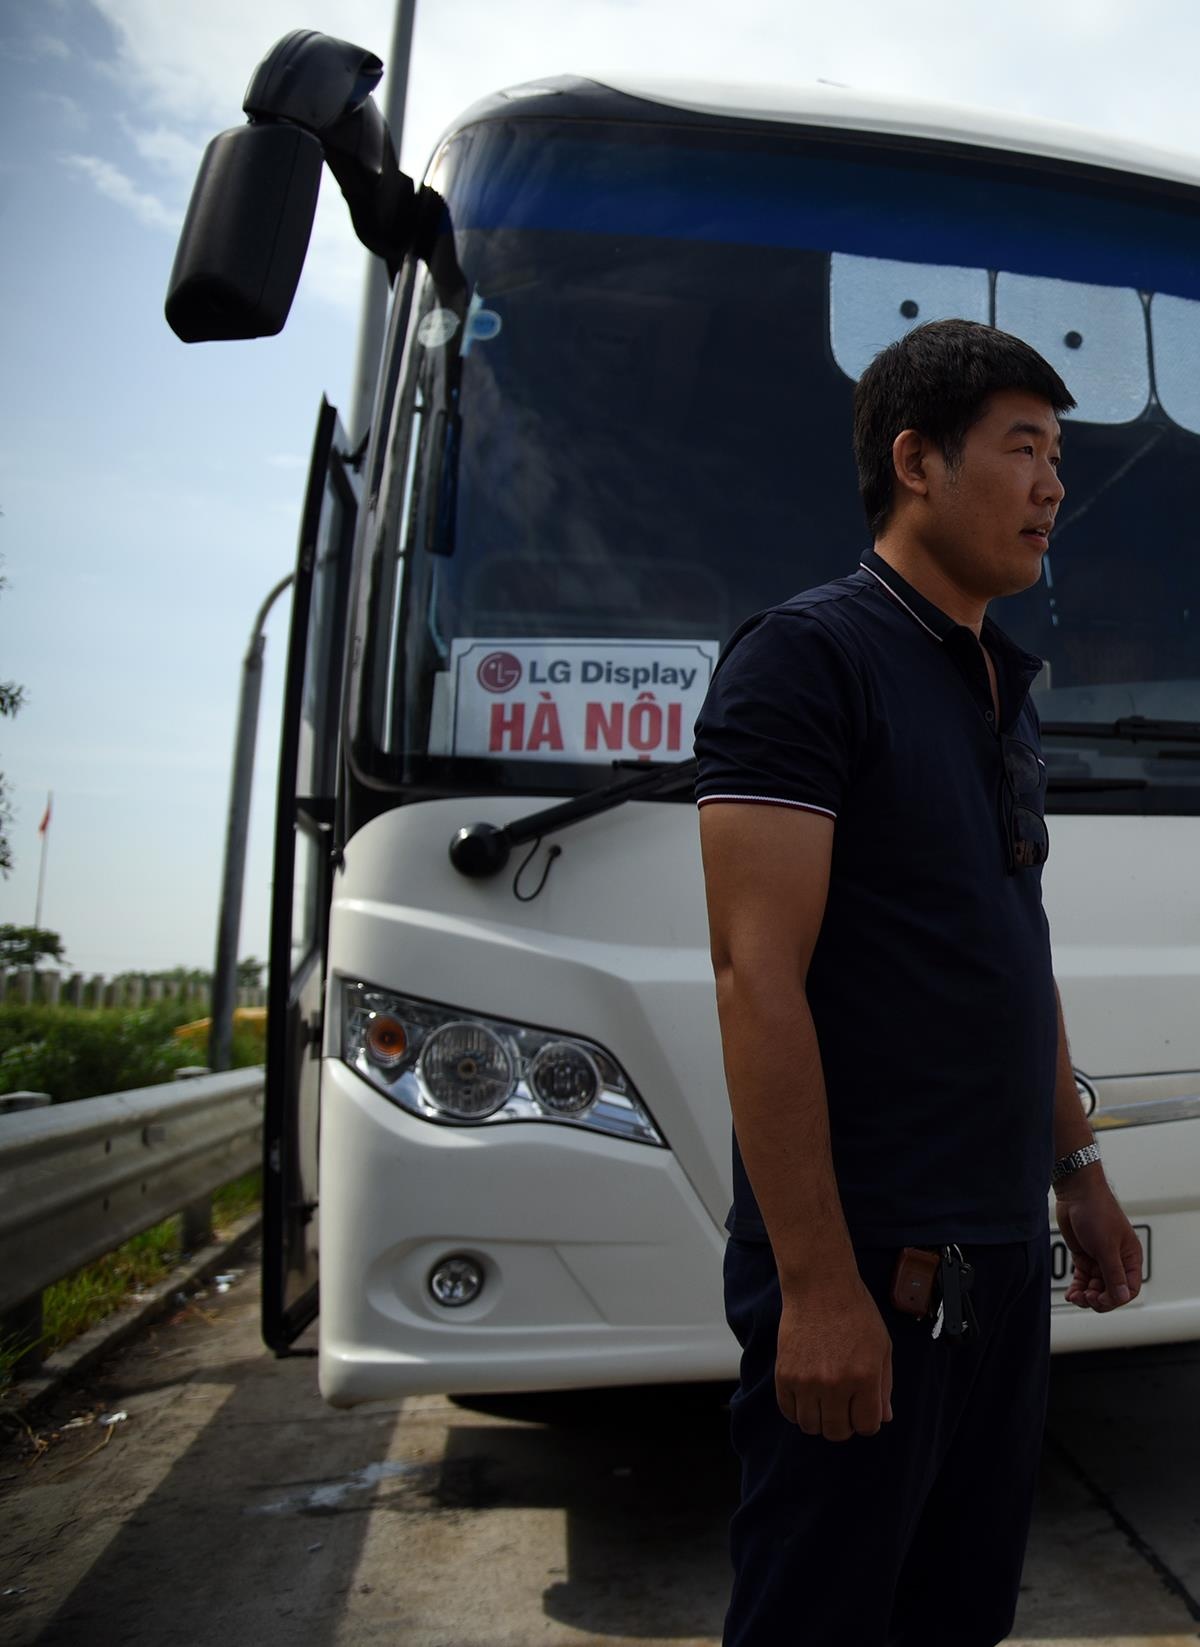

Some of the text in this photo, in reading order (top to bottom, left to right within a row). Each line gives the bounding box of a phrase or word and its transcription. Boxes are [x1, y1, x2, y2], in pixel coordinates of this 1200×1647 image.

[529, 661, 697, 690] LG Display
[489, 691, 682, 762] HÀ NỘI
